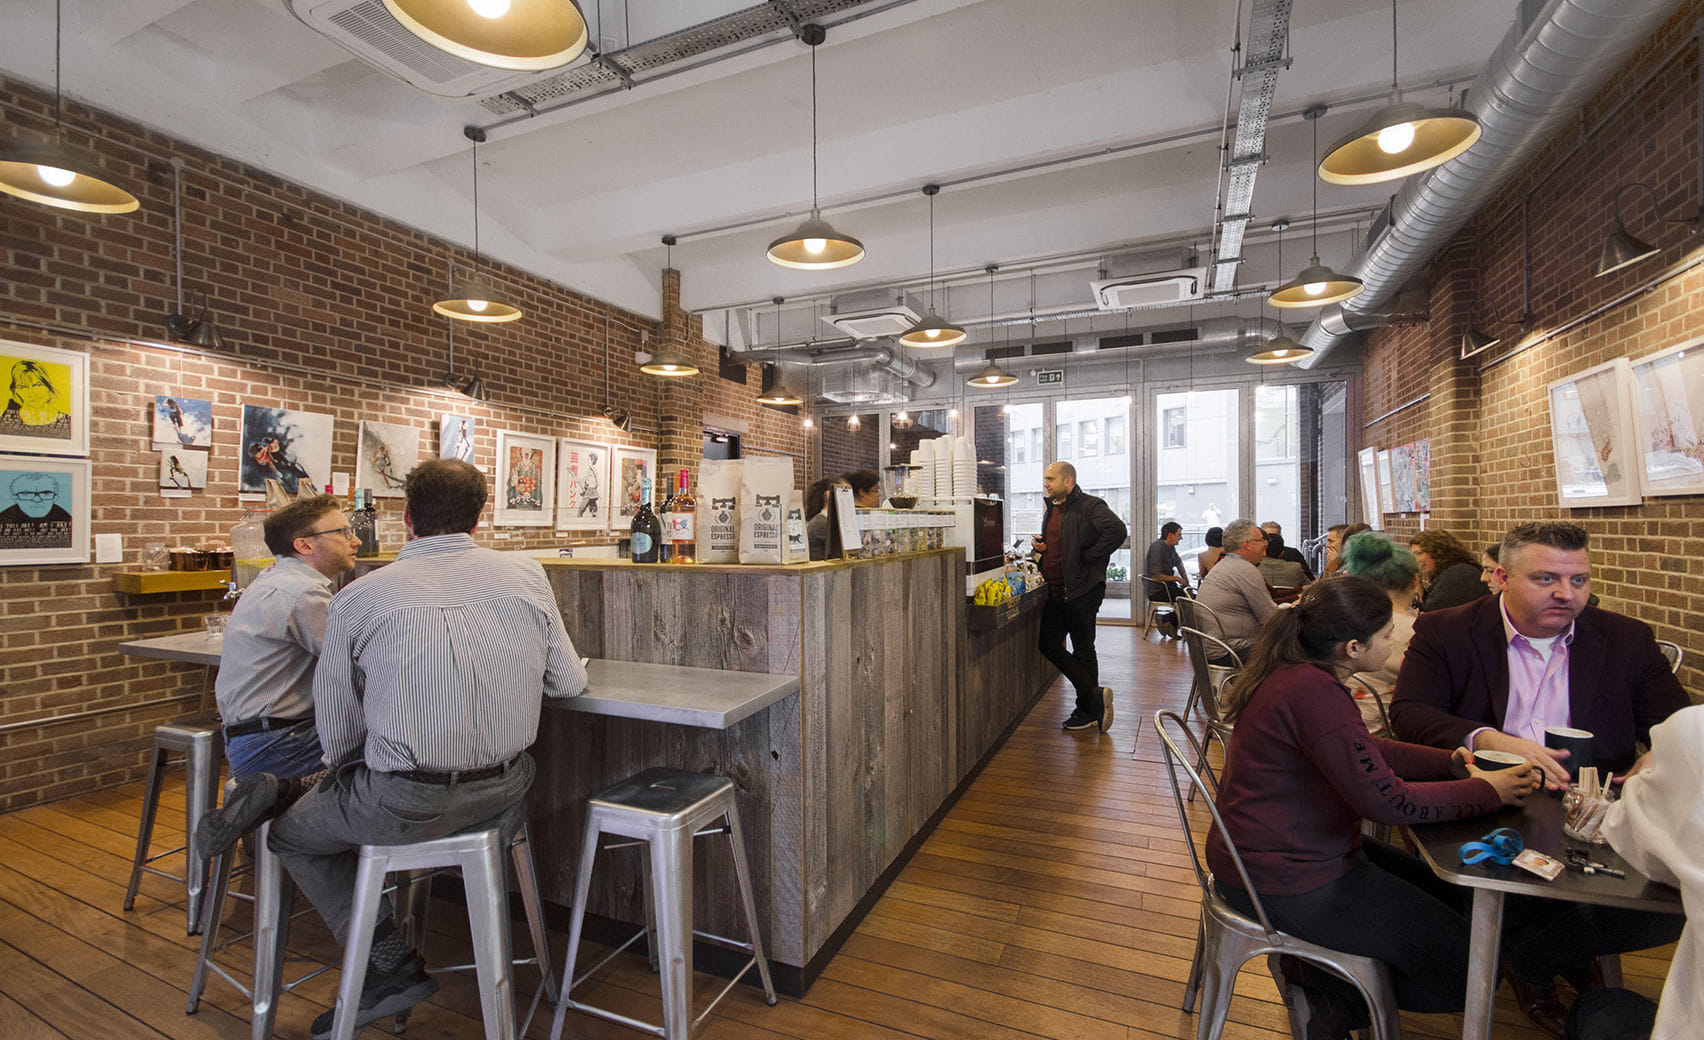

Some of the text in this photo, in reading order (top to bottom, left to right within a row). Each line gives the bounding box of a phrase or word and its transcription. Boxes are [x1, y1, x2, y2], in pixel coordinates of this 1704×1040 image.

[754, 523, 778, 531] ORIGINAL
[1353, 739, 1487, 821] ALL ABOUT ME
